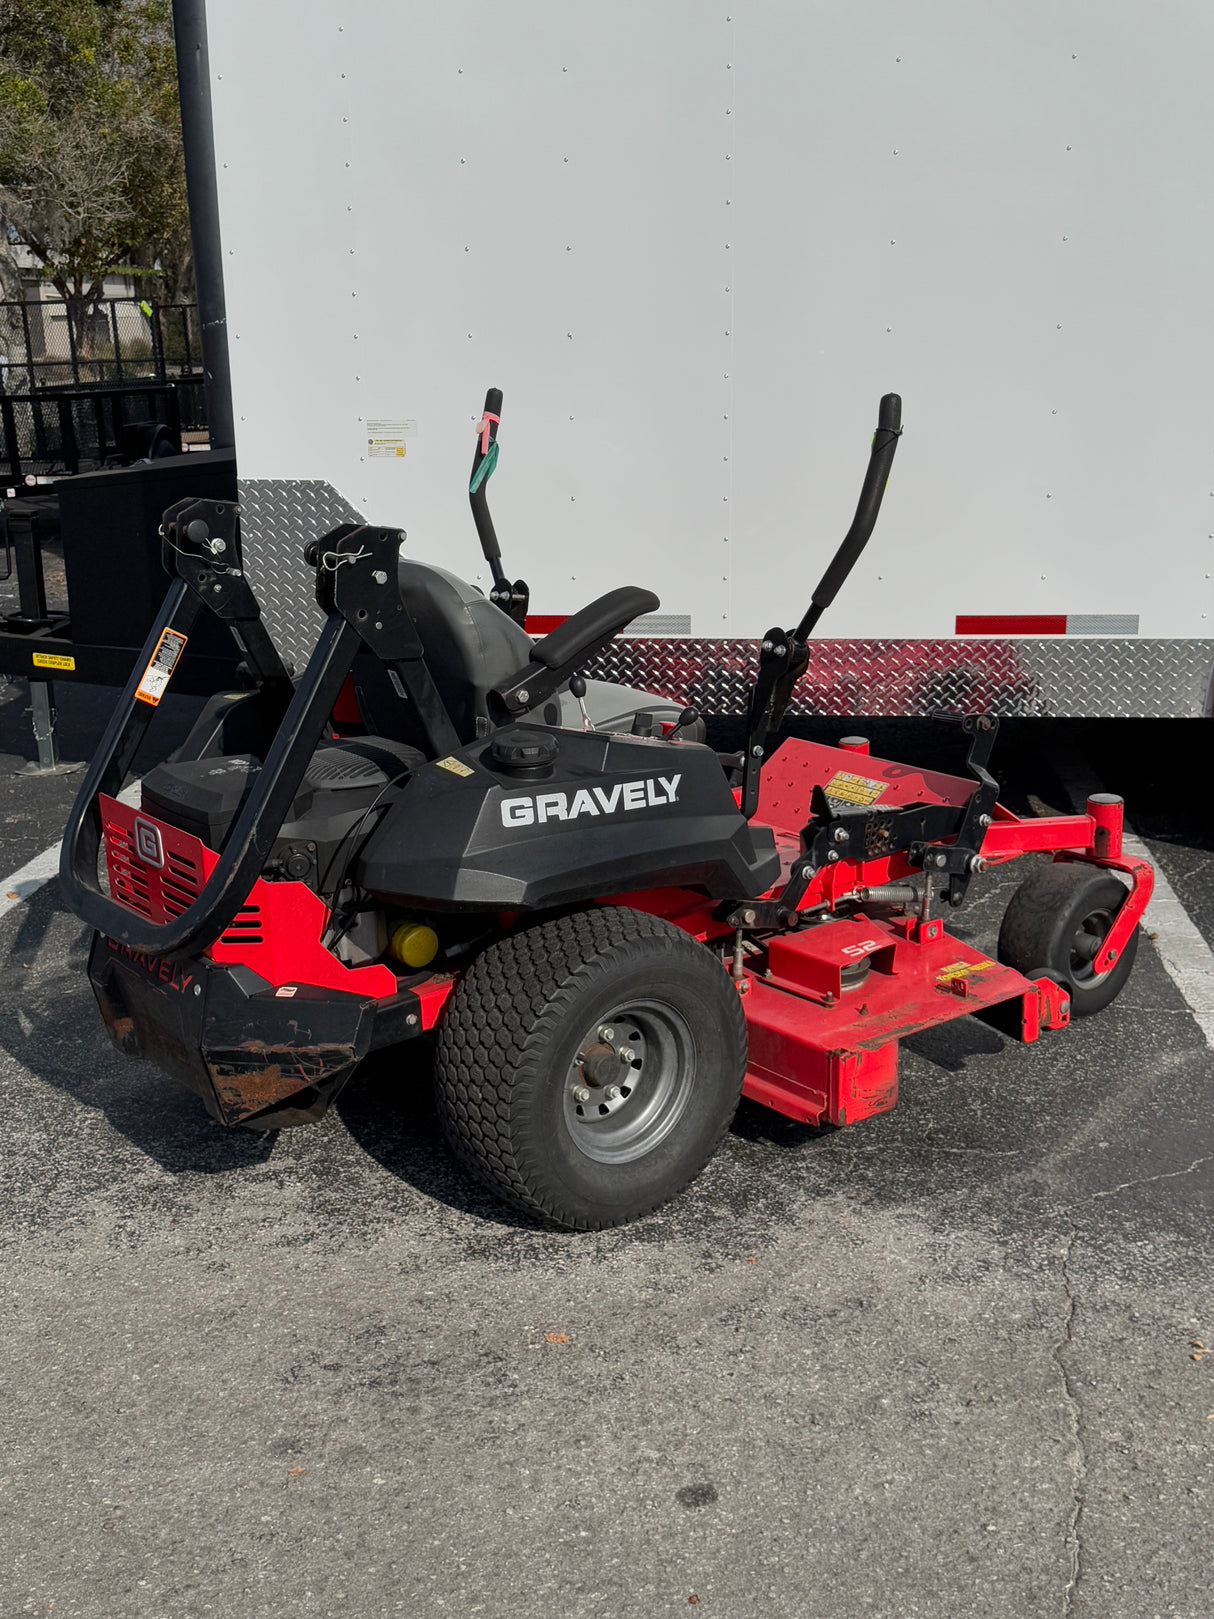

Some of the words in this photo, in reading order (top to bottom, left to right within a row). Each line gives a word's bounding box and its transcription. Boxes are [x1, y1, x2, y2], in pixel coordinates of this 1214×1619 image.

[500, 774, 682, 827] GRAVELY
[139, 828, 157, 857] G
[841, 939, 883, 957] 52
